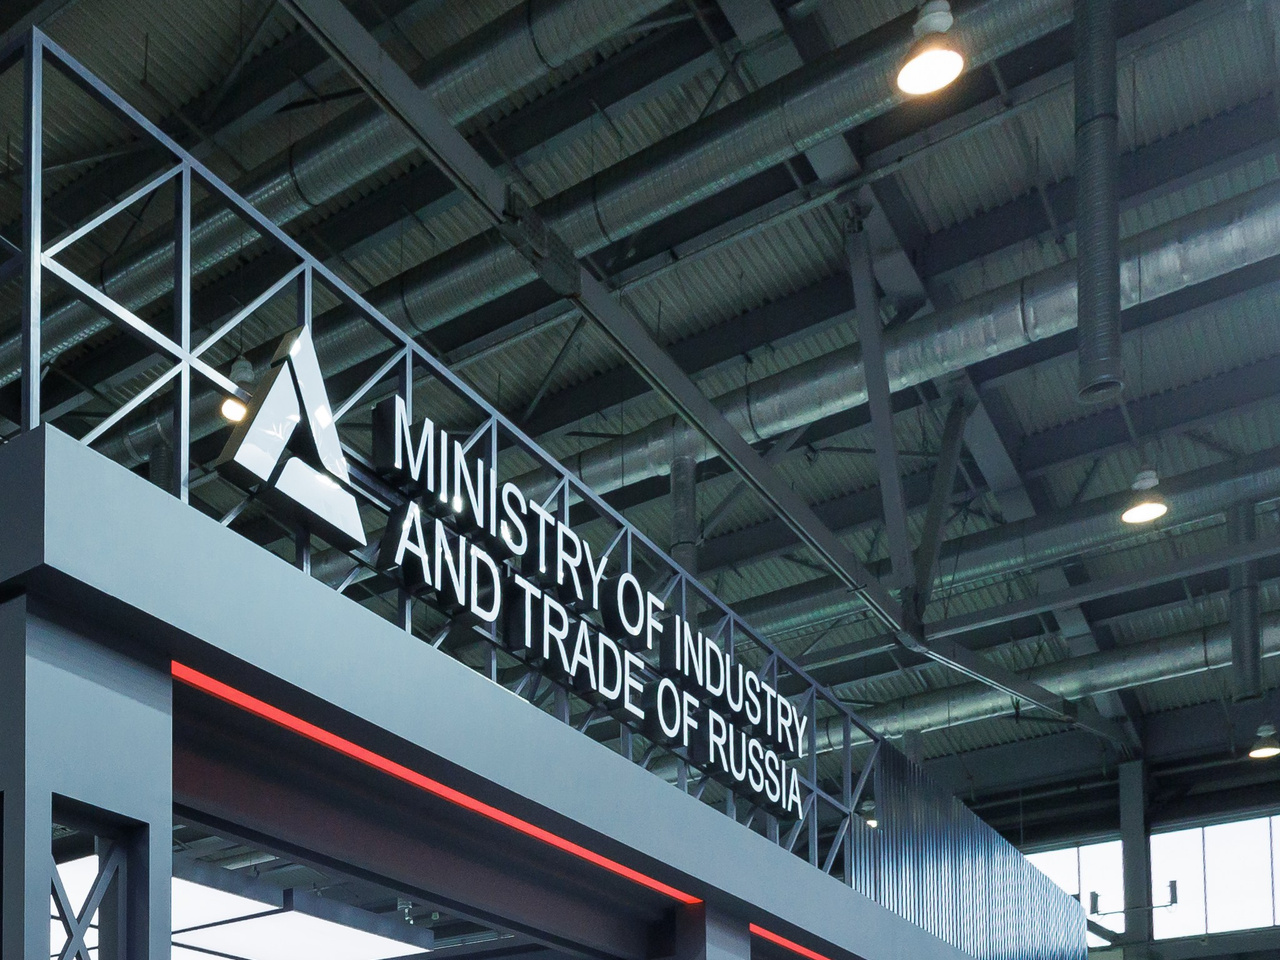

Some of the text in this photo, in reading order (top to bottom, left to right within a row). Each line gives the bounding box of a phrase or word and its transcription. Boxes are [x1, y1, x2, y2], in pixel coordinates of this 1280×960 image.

[394, 395, 808, 758] MINISTRY OF INDUSTRY
[394, 500, 804, 819] AND TRADE OF RUSSIA
